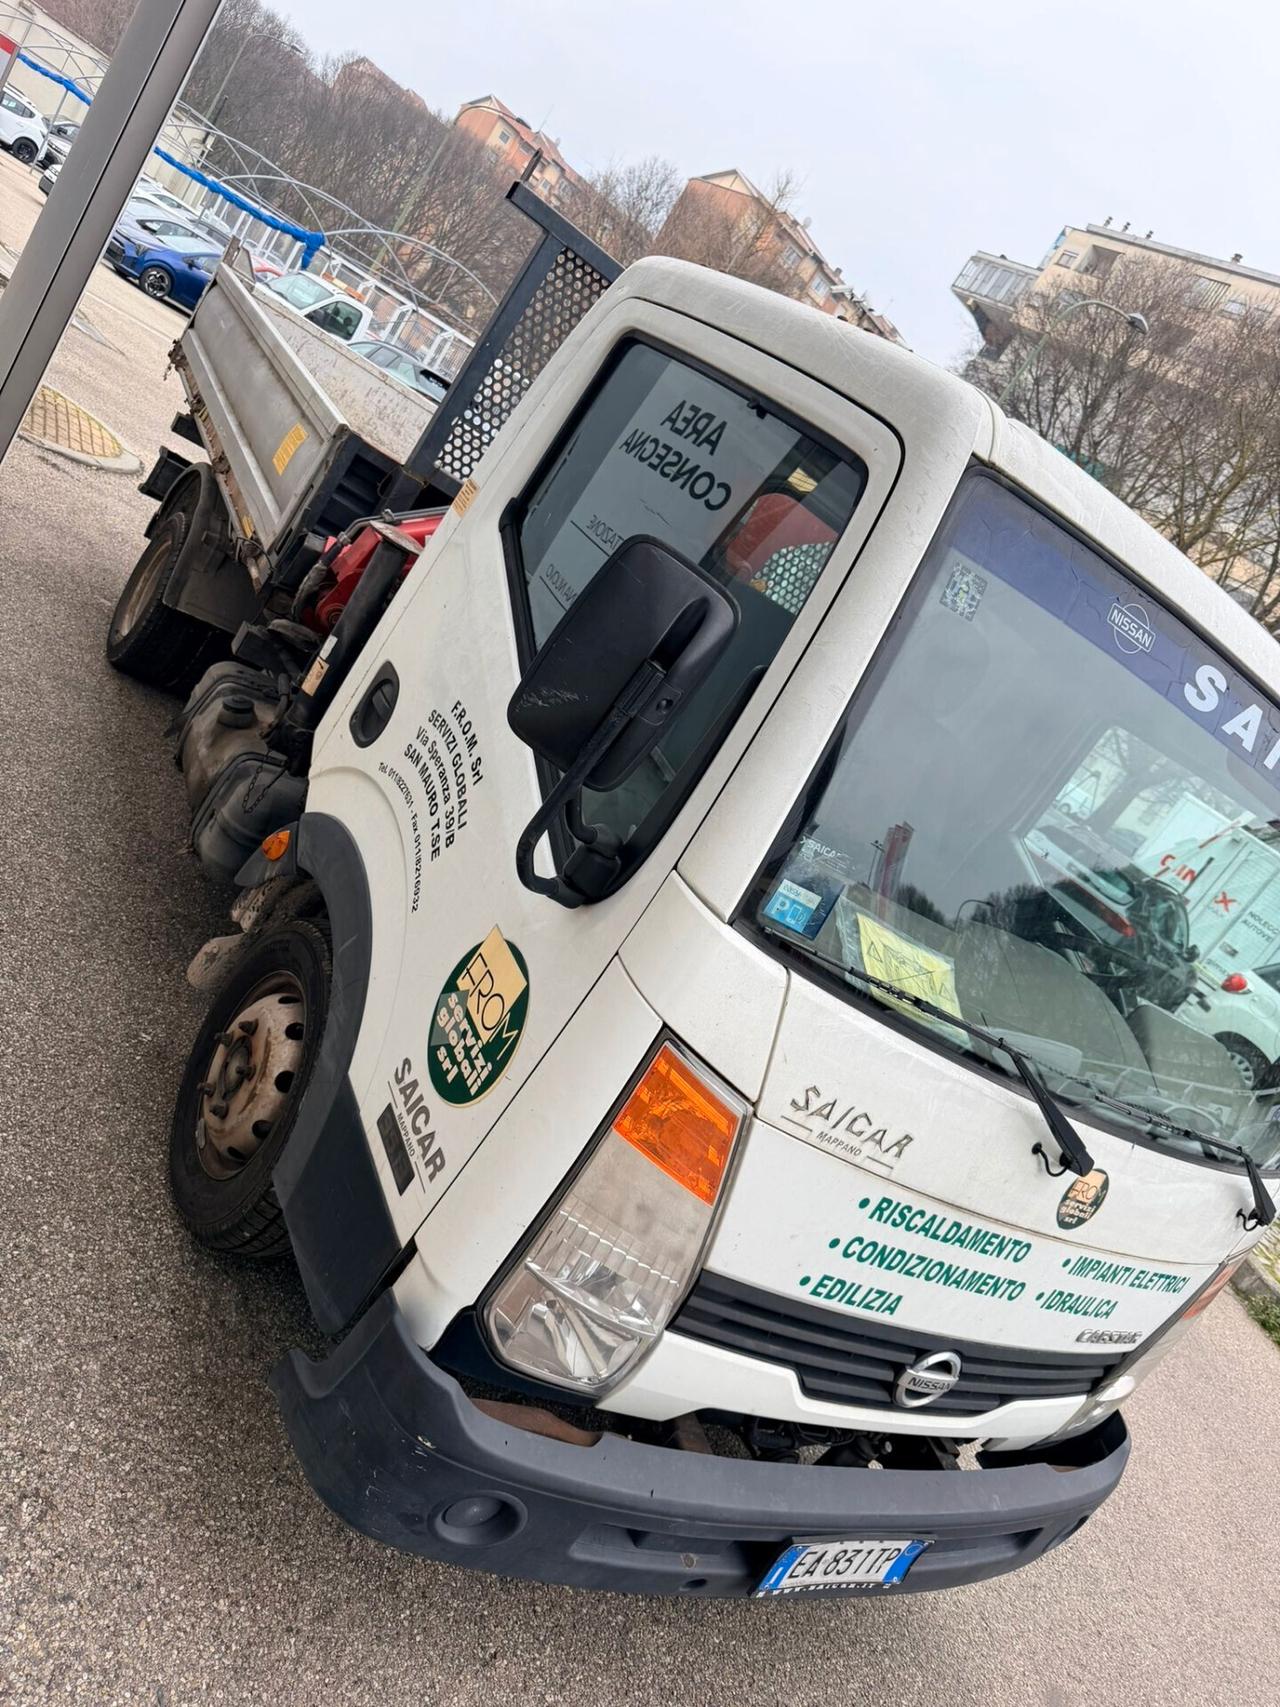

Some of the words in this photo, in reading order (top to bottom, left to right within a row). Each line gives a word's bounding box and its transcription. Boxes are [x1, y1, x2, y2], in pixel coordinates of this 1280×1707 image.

[1110, 609, 1152, 648] NISSAN
[415, 726, 430, 747] Via
[427, 740, 451, 805] Speranza
[428, 709, 459, 755] SERVIZI
[451, 755, 467, 830] GLOBALI
[471, 757, 484, 787] Srl
[404, 743, 421, 769] SAN
[418, 766, 439, 817] MAURO
[430, 817, 441, 862] T.SE
[448, 992, 493, 1081] servizi
[462, 953, 519, 1061] FROM
[437, 1007, 484, 1096] globali
[437, 1046, 458, 1084] srl
[394, 1057, 446, 1184] SAICAR
[396, 1112, 416, 1158] MAPPANO
[790, 1085, 915, 1158] SAICAR
[816, 1130, 863, 1157] MAPPANO
[868, 1197, 1032, 1263] RISCALDAMENTO
[809, 1274, 903, 1315] EDILIZIA
[842, 1236, 1027, 1301] CONDIZIONAMENTO
[1068, 1256, 1136, 1287] IMPIANTI
[1129, 1269, 1191, 1294] ELETTRICI
[1040, 1289, 1119, 1319] IDRAULICA
[908, 1377, 951, 1391] NISSAN
